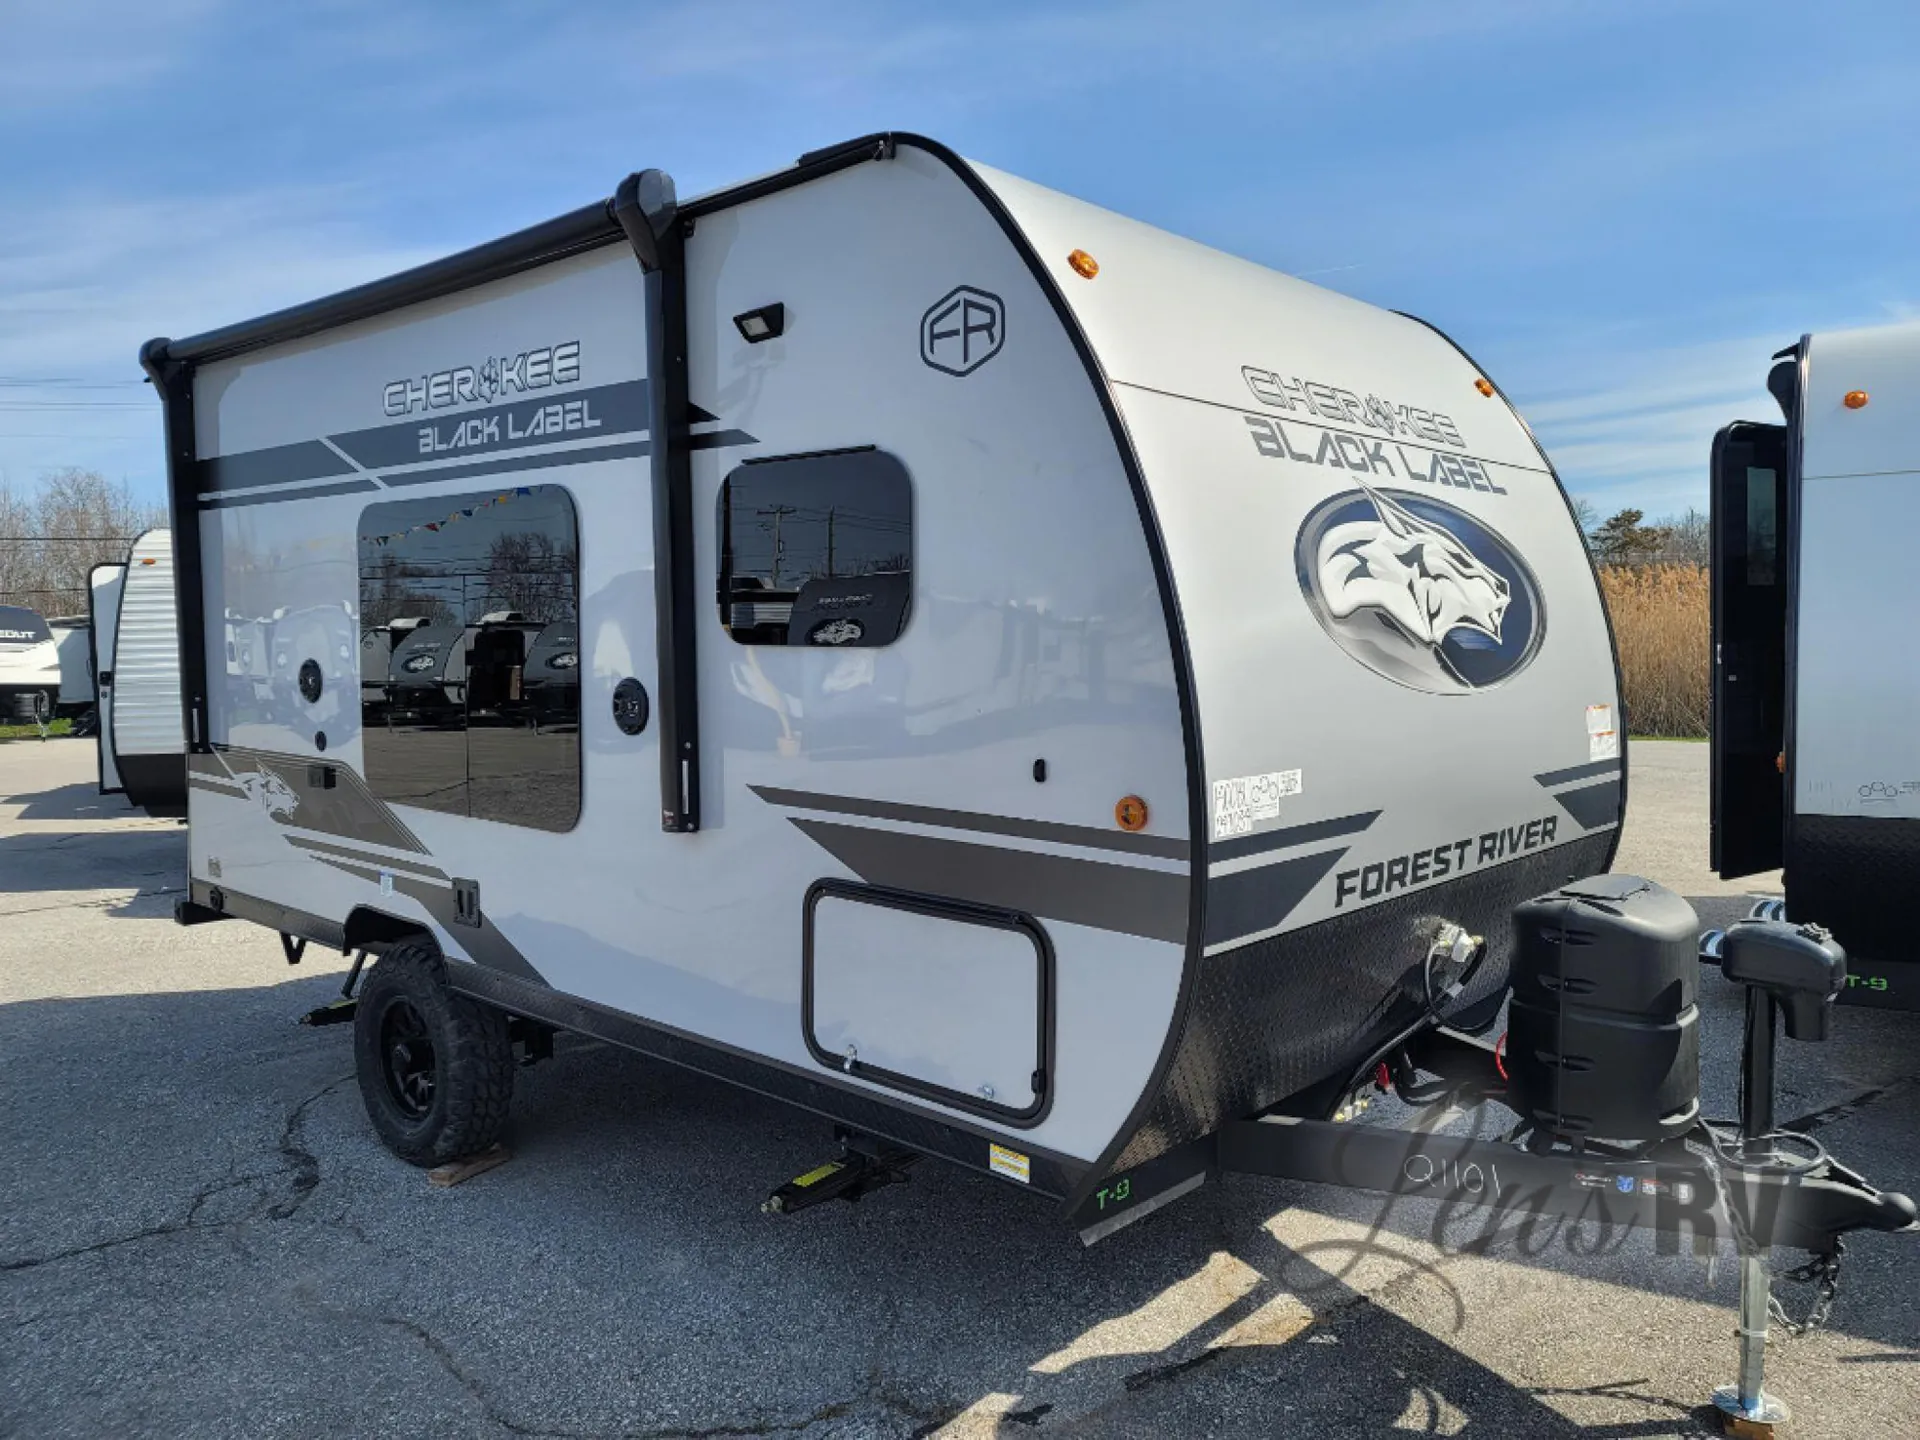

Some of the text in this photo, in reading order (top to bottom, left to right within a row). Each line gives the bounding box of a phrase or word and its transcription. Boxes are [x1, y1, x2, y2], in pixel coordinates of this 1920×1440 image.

[418, 399, 602, 454] BLACK LABEL
[1243, 415, 1508, 496] BLACK LABEL
[1334, 815, 1558, 909] FOREST RIVER
[1845, 974, 1888, 991] T-9
[1096, 1178, 1130, 1211] T-9
